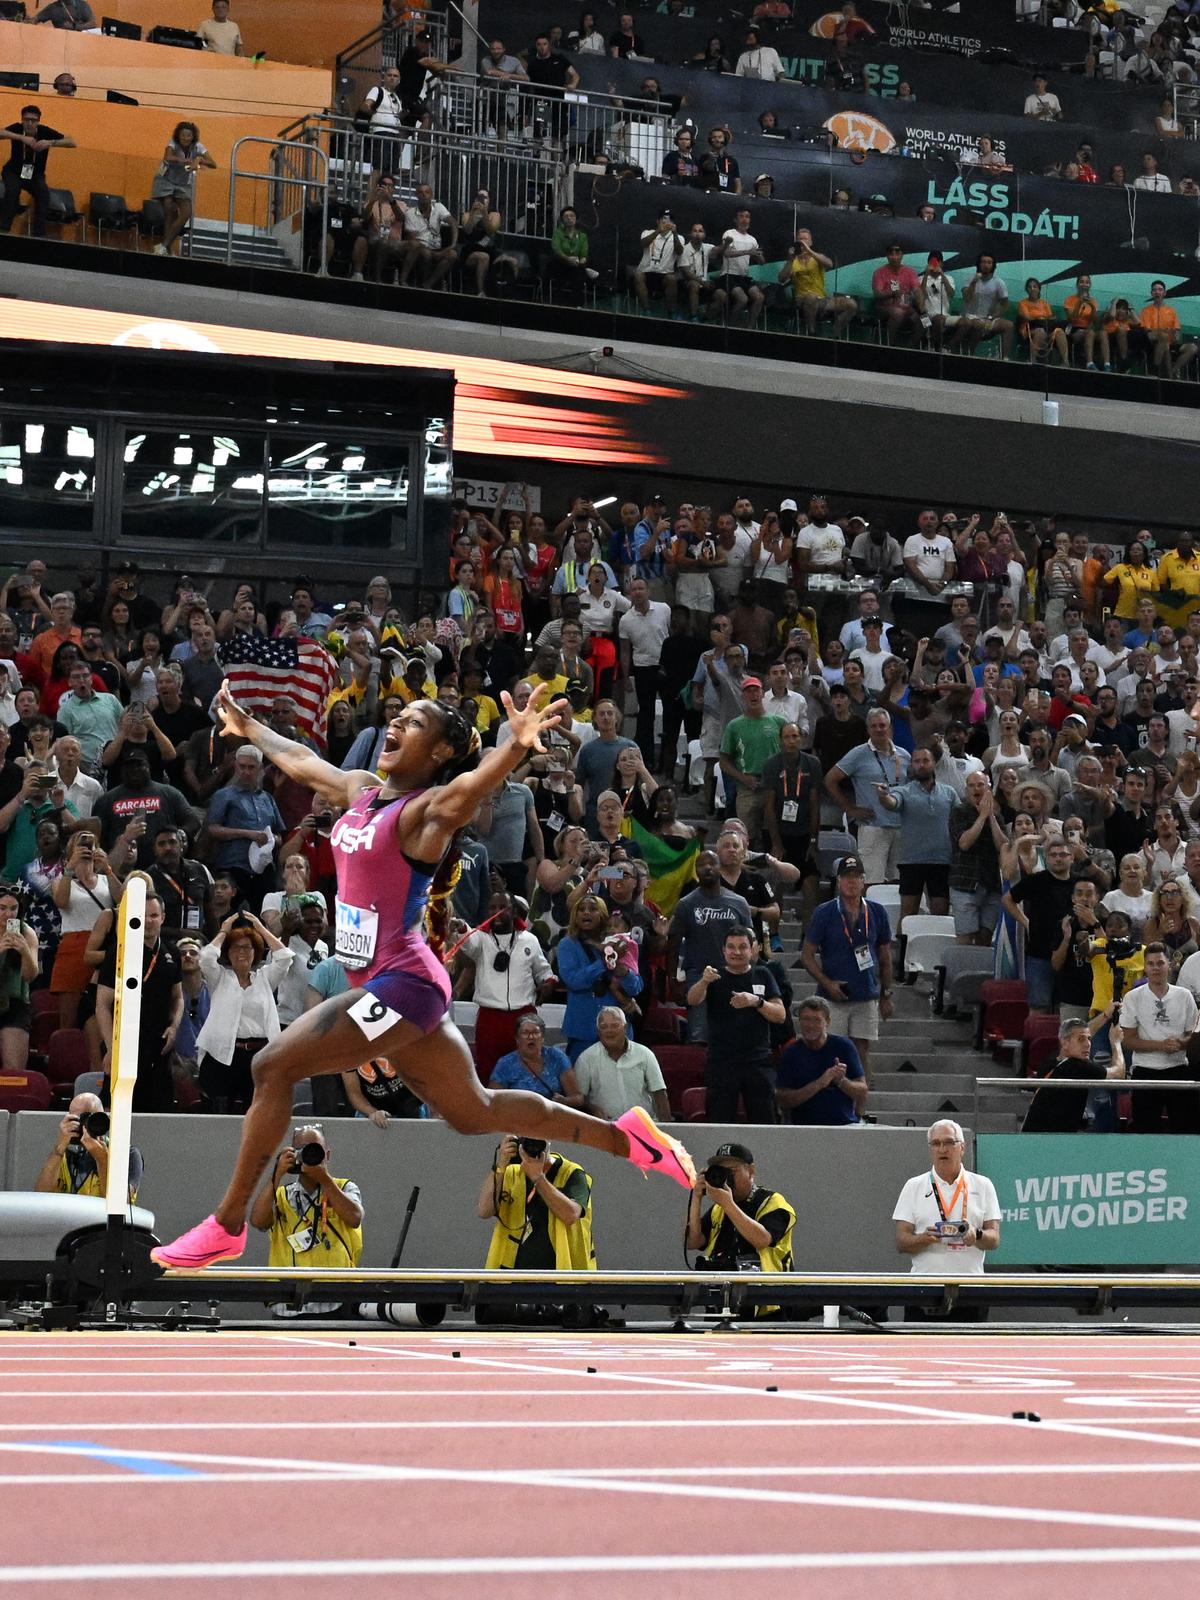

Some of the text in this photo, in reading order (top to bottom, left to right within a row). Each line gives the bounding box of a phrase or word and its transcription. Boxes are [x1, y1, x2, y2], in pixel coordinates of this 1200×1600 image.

[889, 26, 926, 40] WORLD
[928, 32, 981, 48] ATHLETICS
[905, 126, 946, 142] WORLD
[927, 175, 1009, 209] LÁSS
[115, 798, 160, 812] SARCASM
[330, 818, 376, 854] USA
[337, 903, 361, 930] TN
[699, 906, 736, 925] Finals
[361, 1000, 388, 1023] 9
[1014, 1168, 1168, 1204] WITNESS
[1000, 1196, 1188, 1232] THE WONDER
